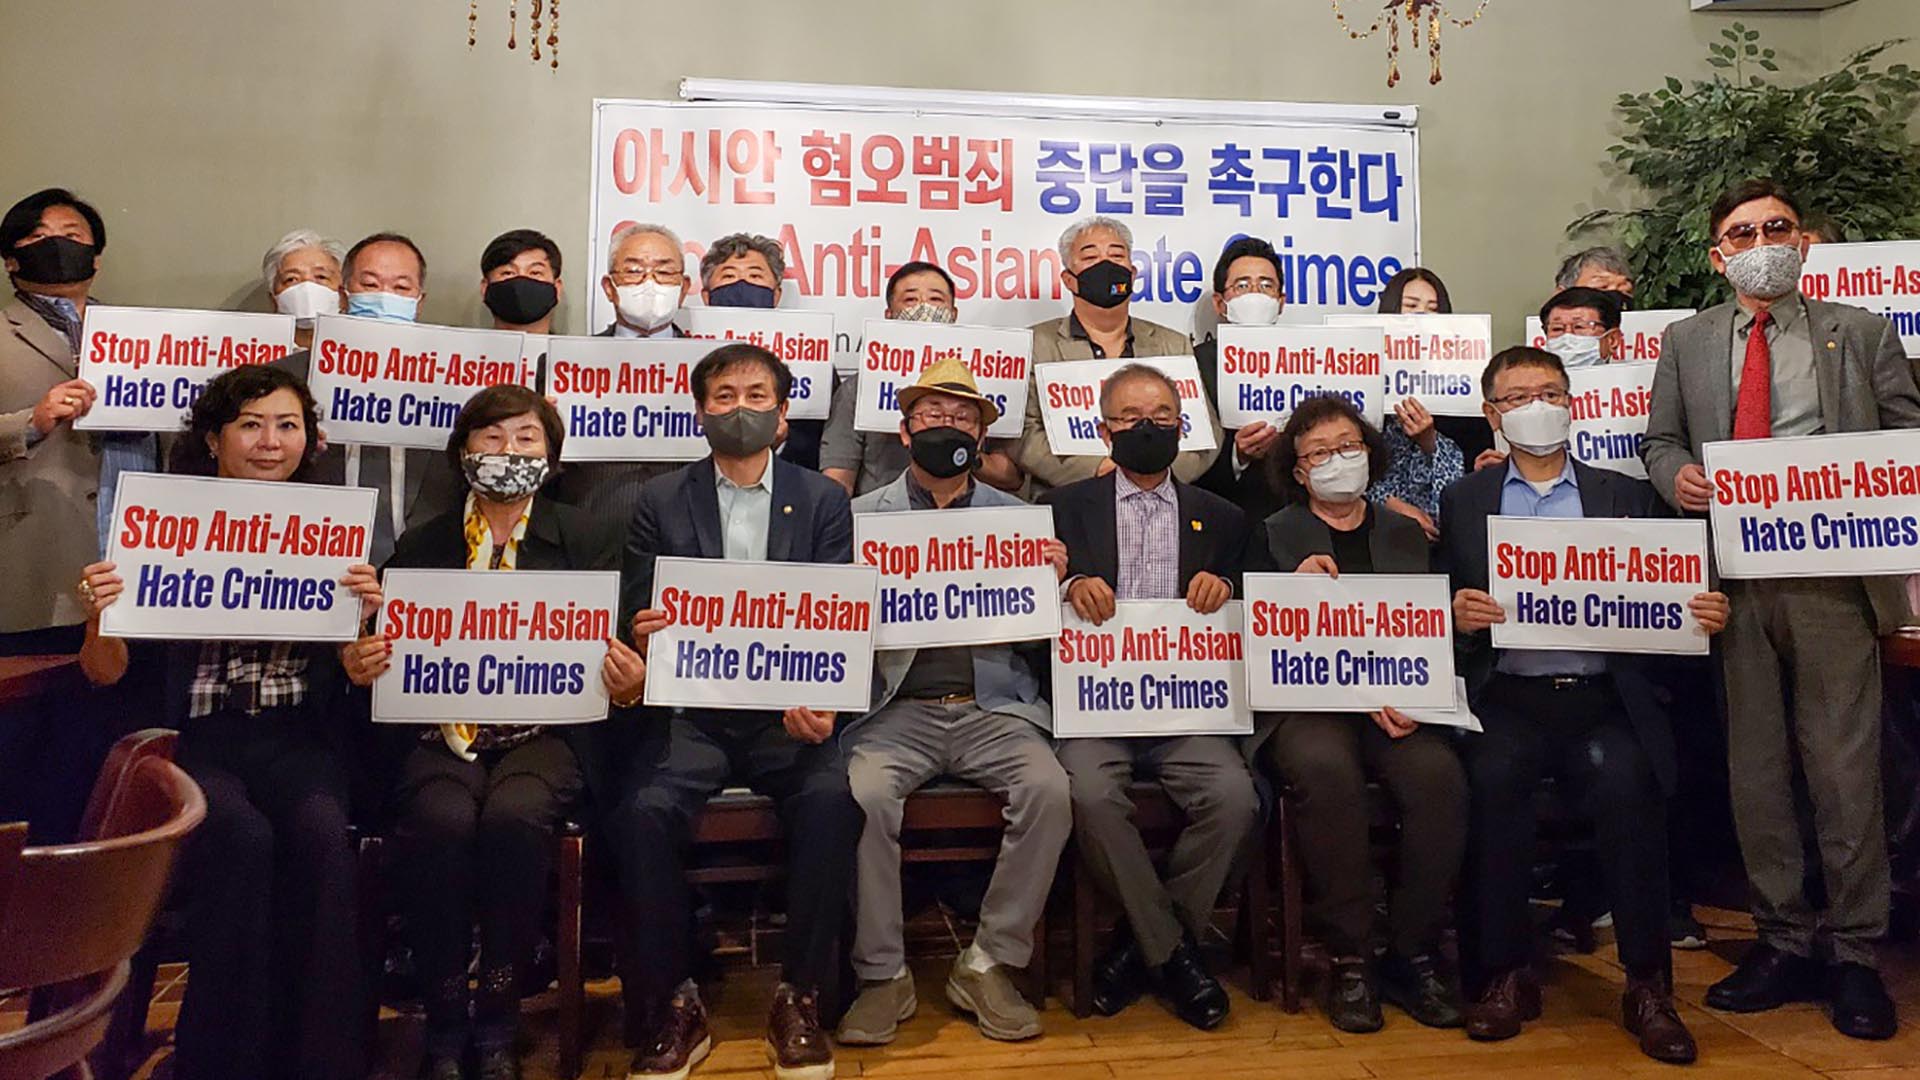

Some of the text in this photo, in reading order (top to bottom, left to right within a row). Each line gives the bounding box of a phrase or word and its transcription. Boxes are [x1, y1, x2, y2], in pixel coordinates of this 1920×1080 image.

[613, 128, 1403, 222] 아시안 혐오범죄 중단을 촉구한다
[1131, 234, 1203, 303] ate
[1837, 265, 1920, 298] Anti-As
[89, 331, 149, 370] Stop
[318, 339, 378, 383] Stop
[383, 347, 515, 388] Anti-Asian
[867, 341, 914, 377] Stop
[1224, 345, 1380, 378] Stop Anti-Asian
[104, 375, 165, 409] Hate
[553, 361, 610, 398] Stop
[616, 362, 692, 395] Anti-A
[1048, 382, 1095, 411] Stop
[1238, 383, 1285, 412] Hate
[1395, 369, 1472, 396] Crimes
[331, 386, 462, 429] Hate Crim
[570, 405, 704, 439] Hate Crime
[1570, 385, 1652, 421] nti-Asi
[1576, 429, 1645, 462] Crim
[1714, 469, 1779, 509] Stop
[121, 505, 365, 558] Stop Anti-Asian
[1740, 512, 1919, 553] Hate Crimes
[926, 533, 1050, 573] Anti-Asian
[1496, 543, 1701, 586] Stop Anti-Asian
[136, 564, 335, 611] Hate Crimes
[880, 583, 1035, 623] Hate Crimes
[385, 598, 610, 646] Stop Anti-Asian
[662, 587, 870, 634] Stop Anti-Asian
[1252, 600, 1446, 642] Stop Anti-Asian
[1517, 592, 1683, 630] Hate Crimes
[675, 640, 847, 684] Hate Crimes
[1059, 626, 1243, 668] Stop Anti-Asian
[403, 655, 585, 695] Hate Crimes
[1271, 649, 1430, 686] Hate Crimes
[1078, 674, 1229, 711] Hate Crimes
